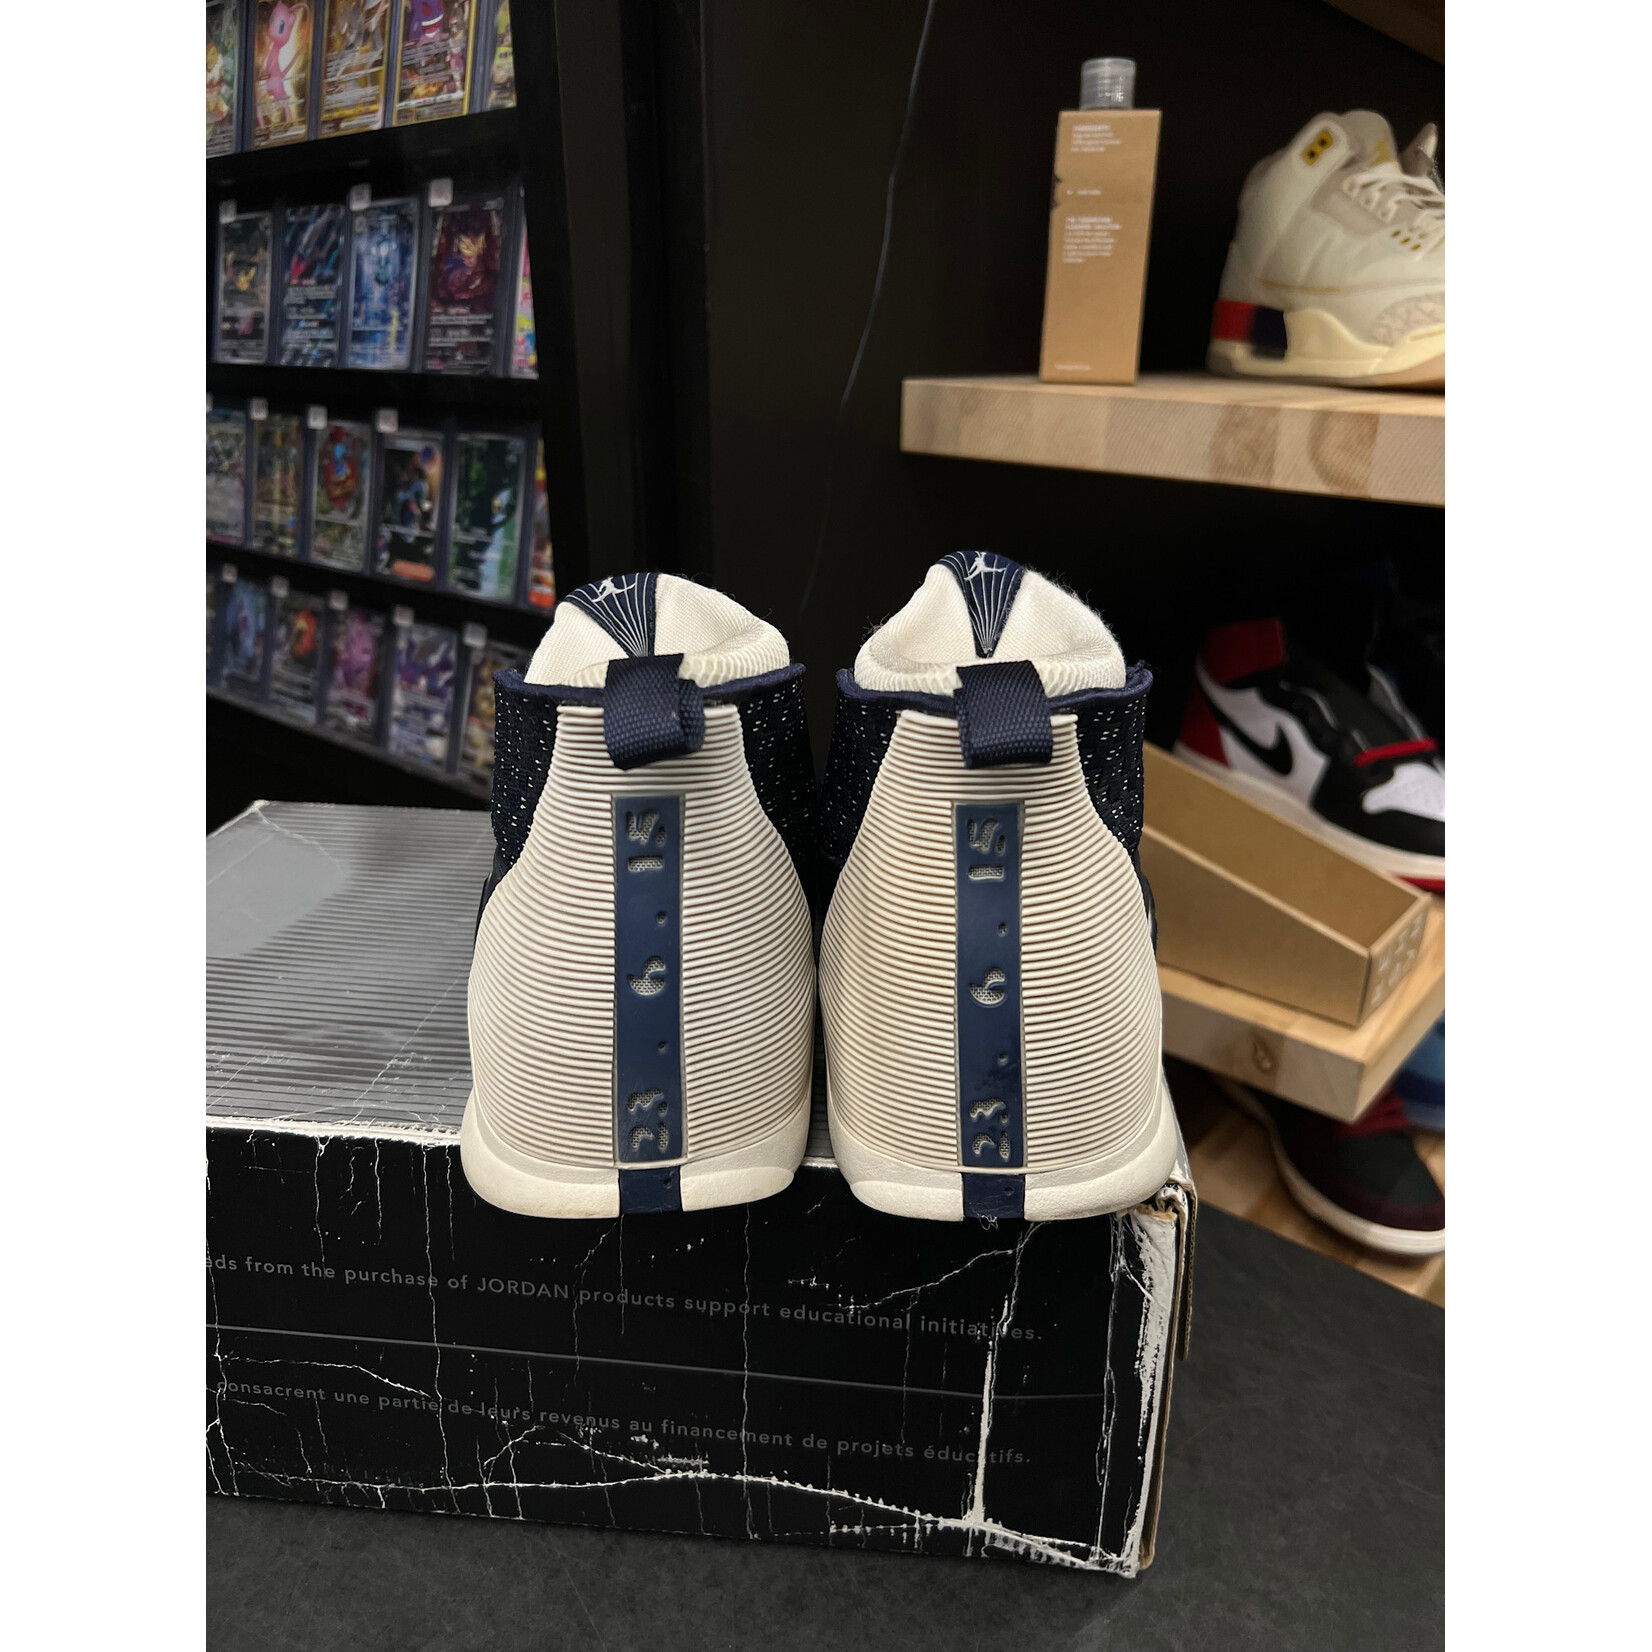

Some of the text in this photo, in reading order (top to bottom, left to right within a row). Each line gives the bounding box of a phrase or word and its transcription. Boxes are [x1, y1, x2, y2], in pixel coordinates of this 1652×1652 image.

[245, 1256, 294, 1275] from
[301, 1261, 336, 1278] the
[345, 1267, 438, 1287] purchase
[448, 1275, 468, 1289] of
[477, 1277, 569, 1298] JORDAN
[579, 1288, 675, 1308] products
[685, 1299, 770, 1317] support
[780, 1304, 911, 1331] educational
[216, 1381, 1031, 1465] consacrent une partie de leurs revenus au financement de projets éductifs.
